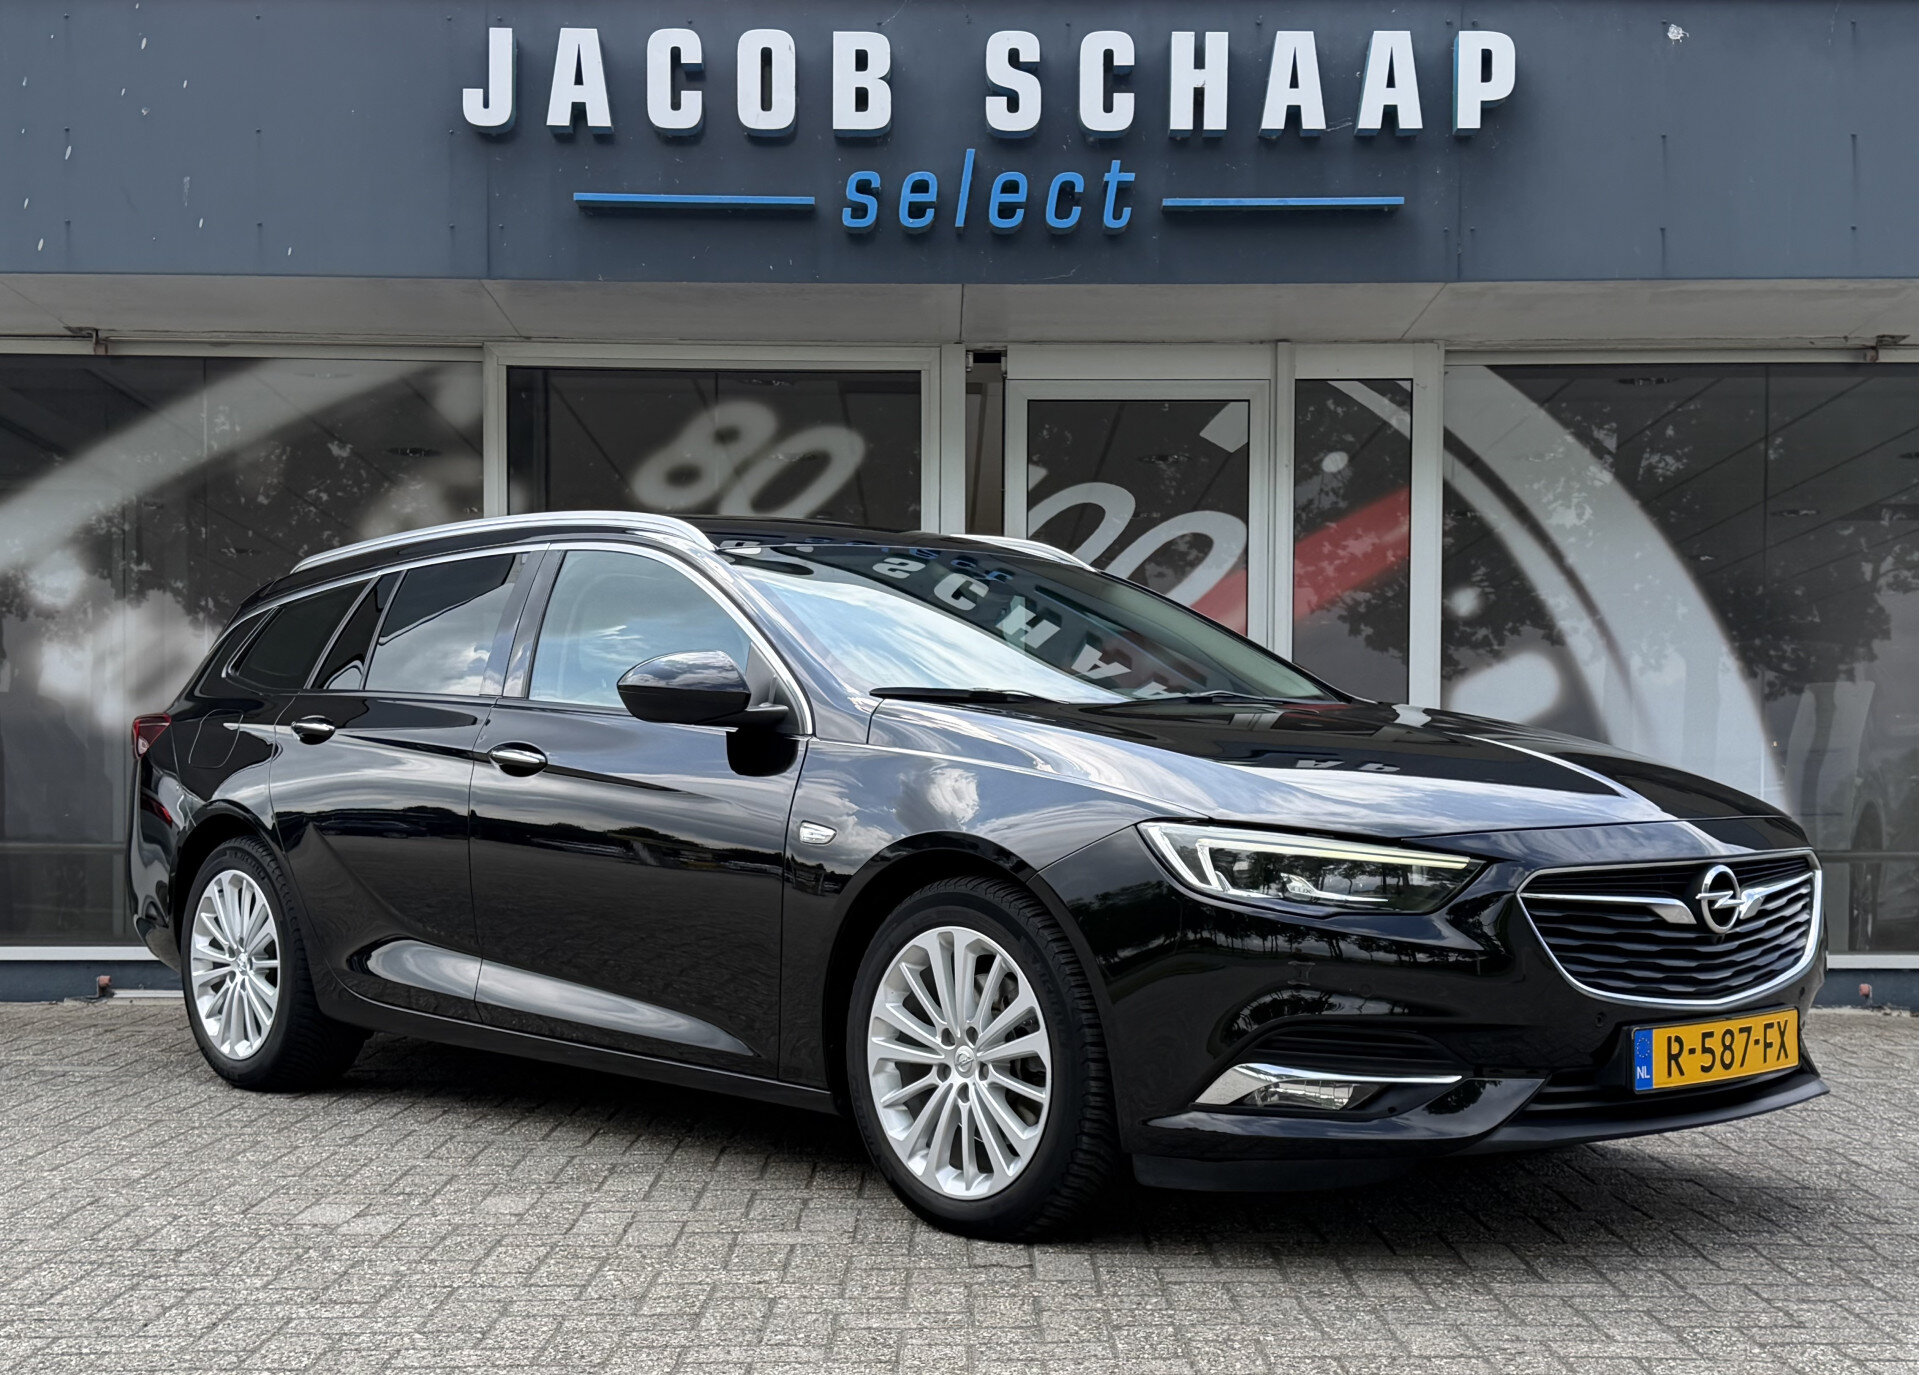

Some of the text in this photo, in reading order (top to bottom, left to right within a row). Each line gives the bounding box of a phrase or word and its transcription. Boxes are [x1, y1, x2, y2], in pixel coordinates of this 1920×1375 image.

[462, 27, 1517, 138] JACOB SCHAAP
[842, 148, 1136, 232] select
[631, 400, 866, 518] 80
[1636, 1065, 1651, 1080] NL
[1666, 1019, 1789, 1079] R-587-FX
